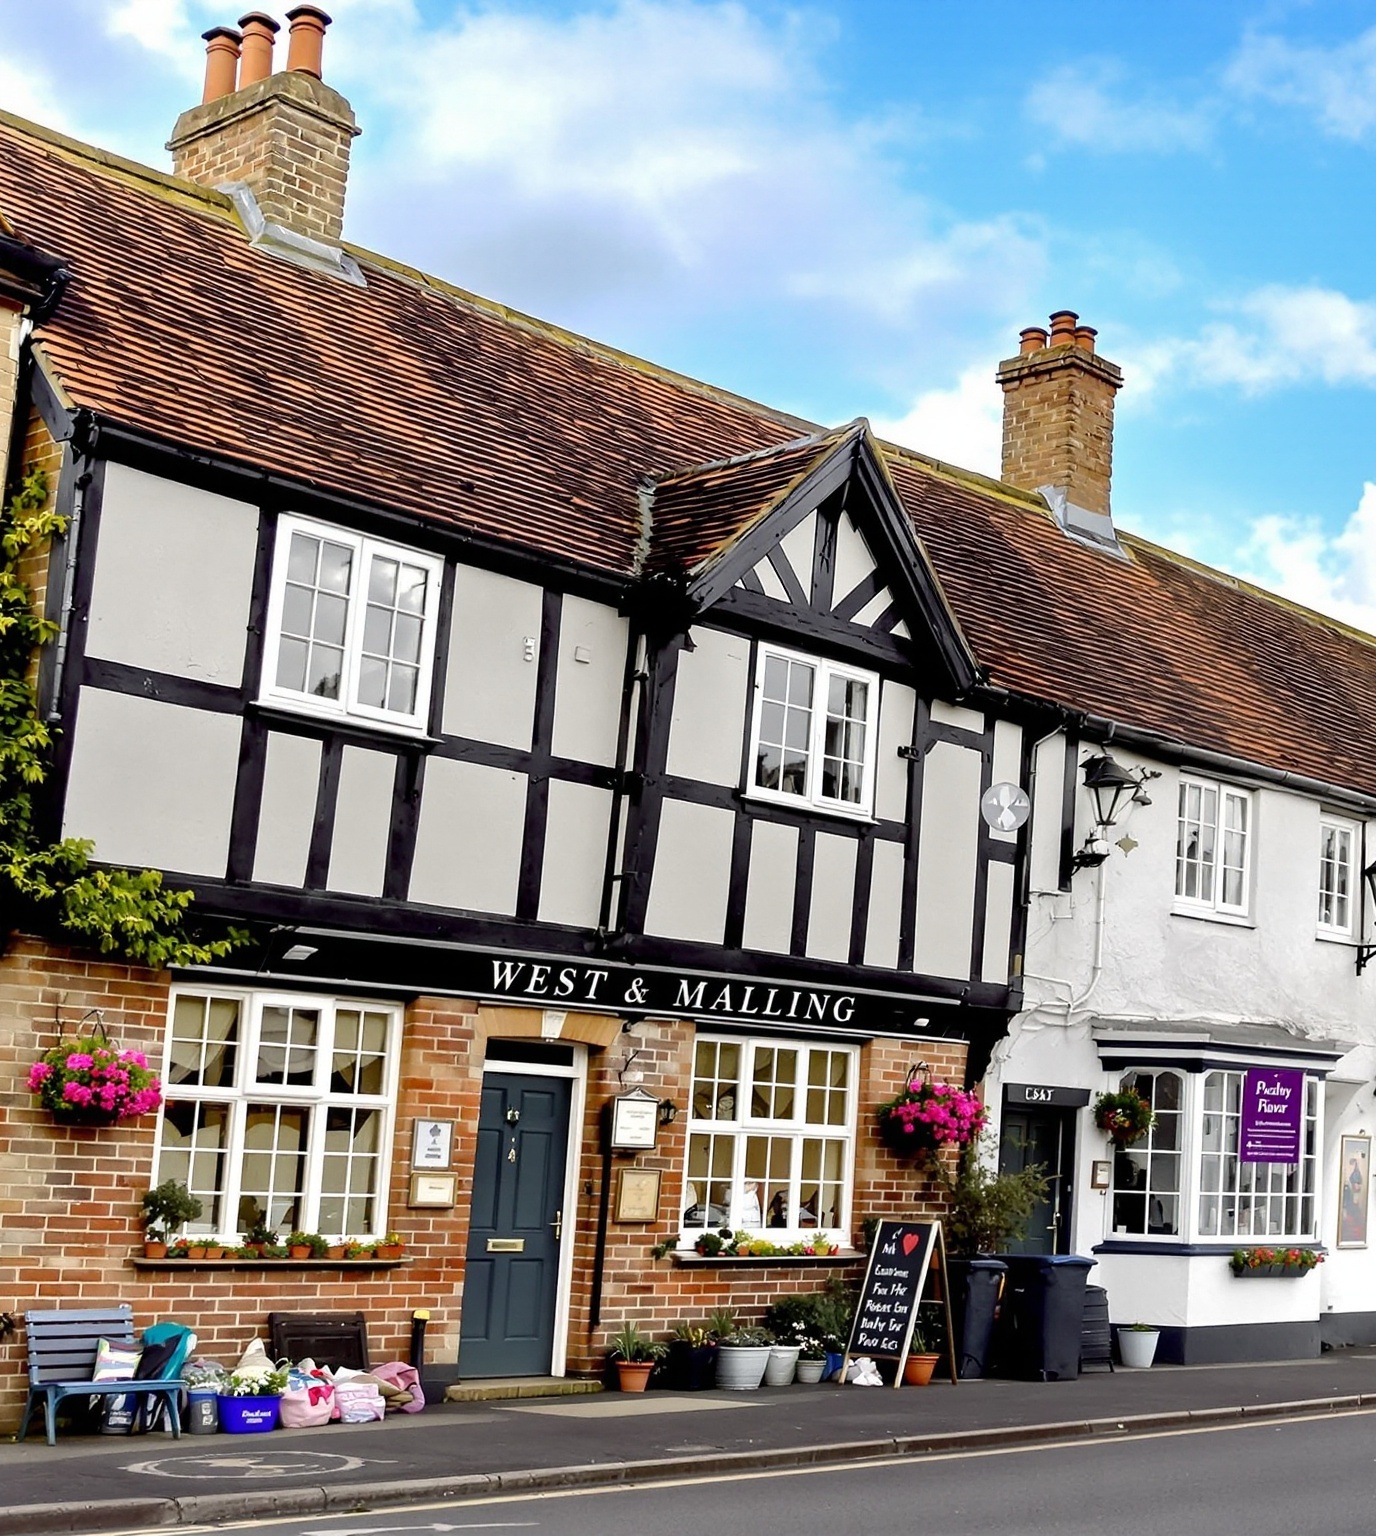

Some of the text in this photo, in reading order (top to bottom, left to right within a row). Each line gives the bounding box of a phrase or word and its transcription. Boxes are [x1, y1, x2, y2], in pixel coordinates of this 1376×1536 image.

[491, 959, 856, 1022] WEST & MALLING
